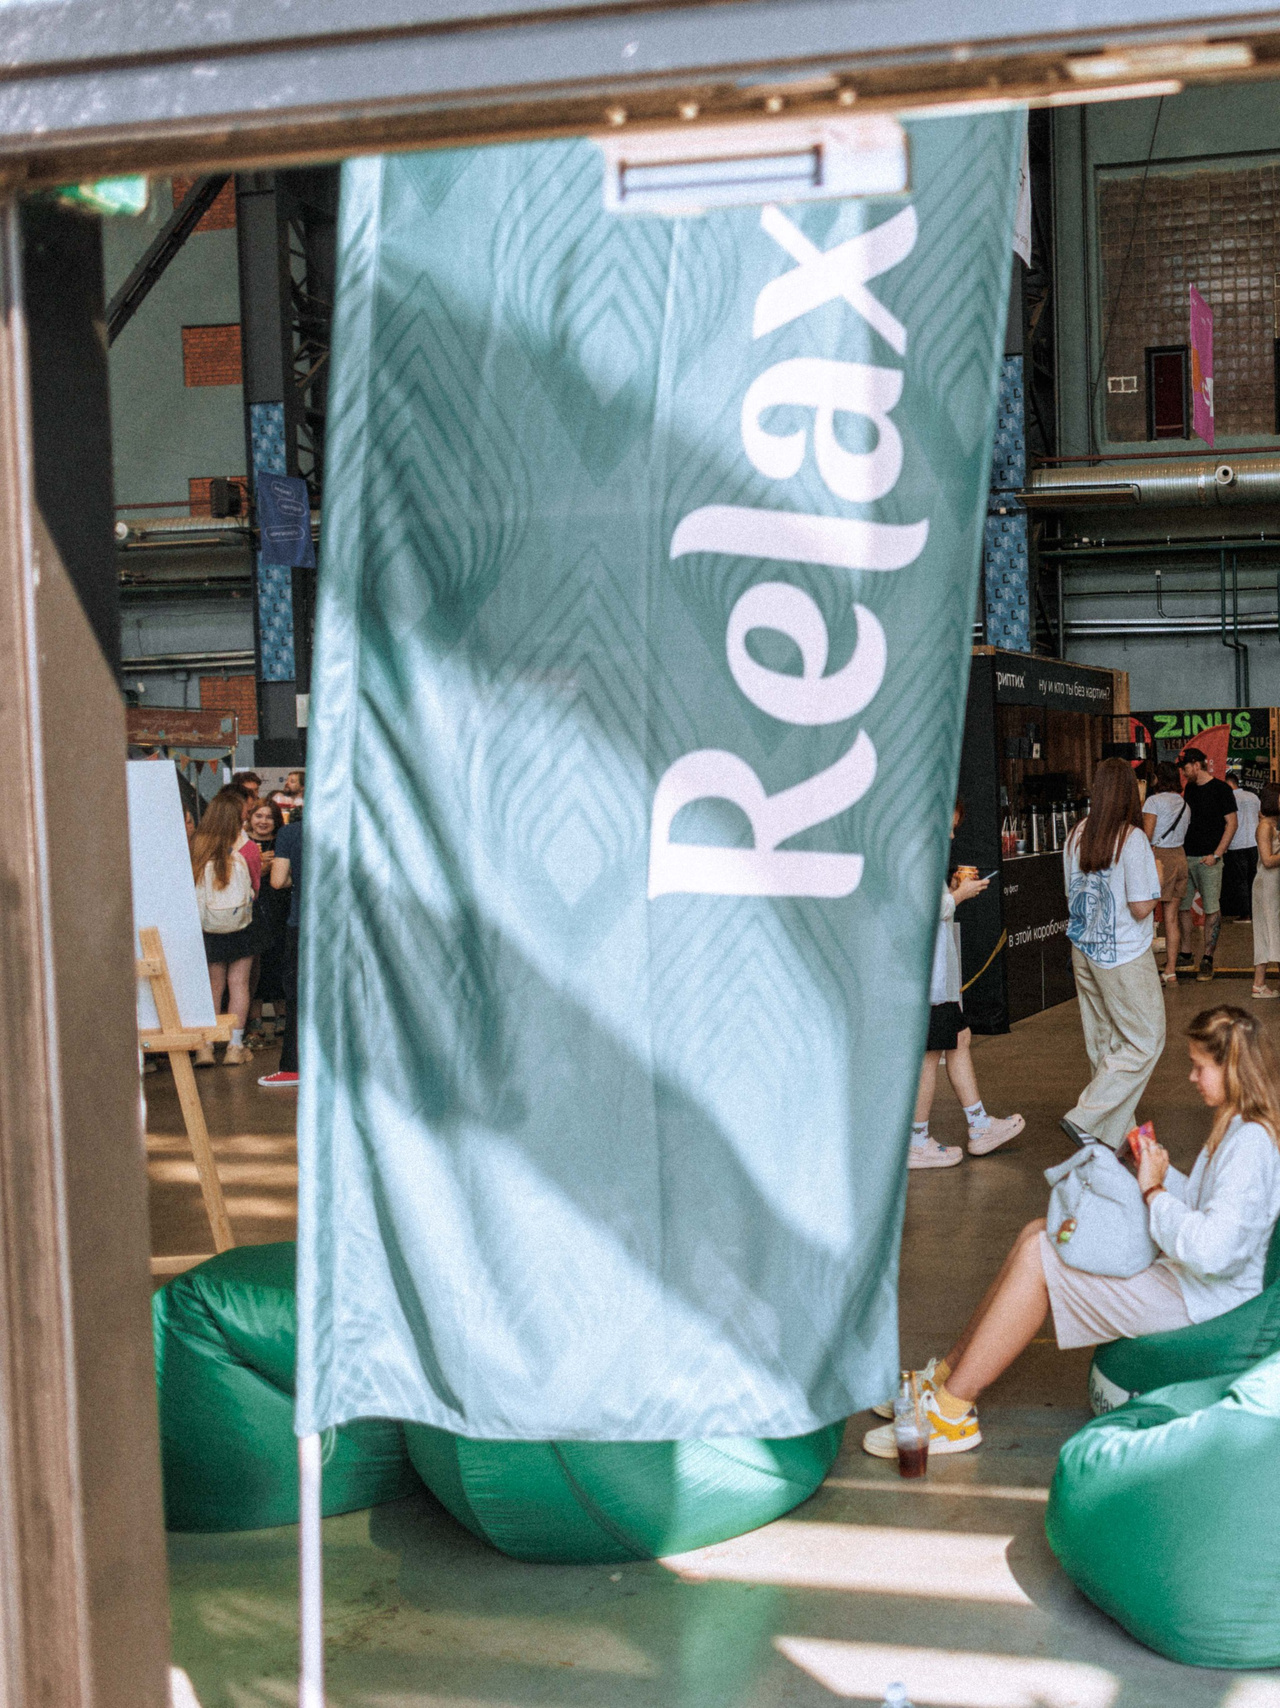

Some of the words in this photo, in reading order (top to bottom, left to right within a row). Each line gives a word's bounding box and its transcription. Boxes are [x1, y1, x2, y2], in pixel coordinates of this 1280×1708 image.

[647, 203, 930, 901] Relax
[996, 671, 1025, 690] риптих
[1039, 680, 1048, 695] ну
[1054, 682, 1064, 694] кто
[1065, 683, 1074, 695] ты
[1074, 681, 1085, 697] без
[1008, 934, 1014, 948] в
[1015, 925, 1032, 946] этой
